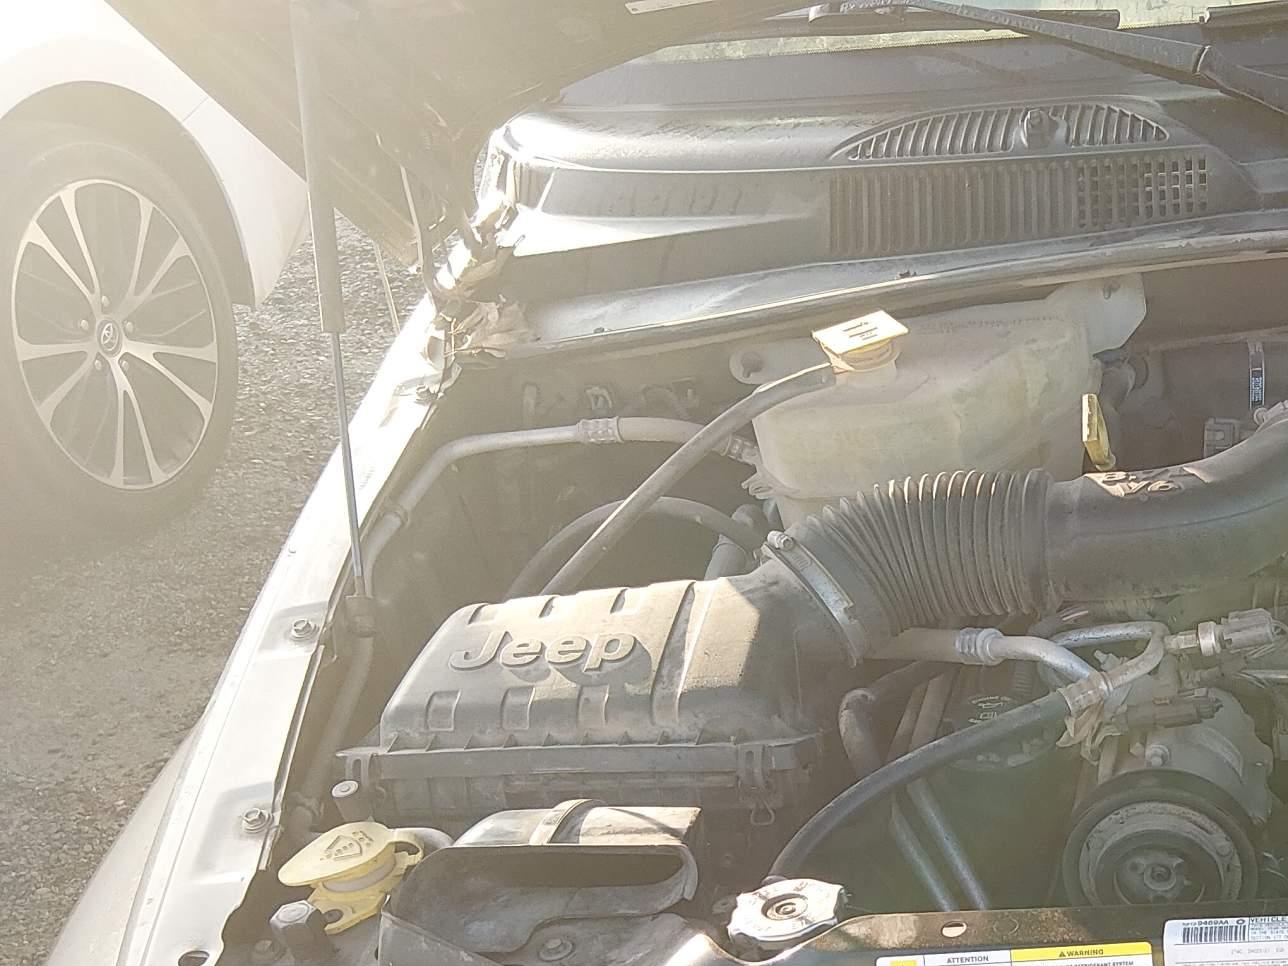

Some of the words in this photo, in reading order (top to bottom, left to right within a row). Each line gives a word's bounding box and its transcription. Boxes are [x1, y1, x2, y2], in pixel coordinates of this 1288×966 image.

[450, 628, 637, 674] Jeep
[1067, 948, 1104, 958] WARNING
[946, 955, 990, 964] ATTENTION
